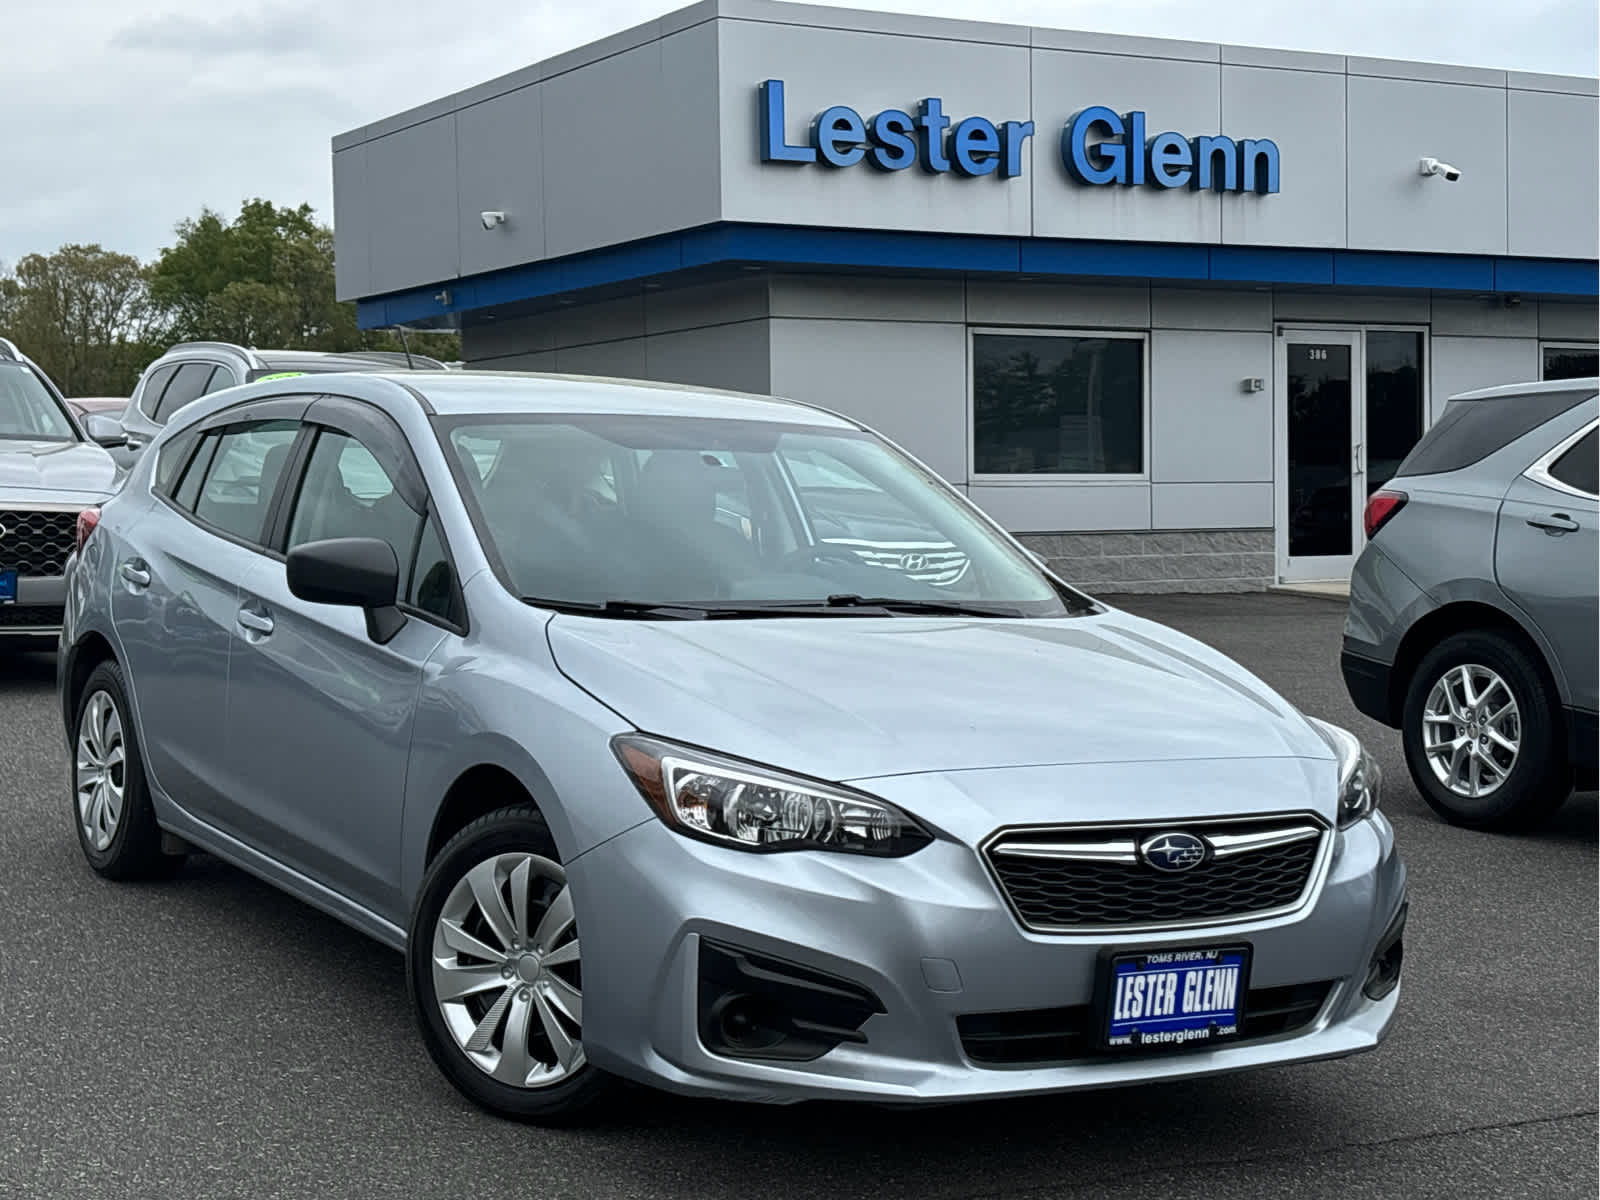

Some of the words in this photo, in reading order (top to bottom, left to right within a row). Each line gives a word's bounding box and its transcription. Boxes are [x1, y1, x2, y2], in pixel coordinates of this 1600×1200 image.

[758, 79, 1034, 178] Lester
[1061, 105, 1280, 194] Glenn
[1147, 955, 1173, 964] TOMS
[1206, 950, 1218, 959] NJ
[1114, 973, 1178, 1020] LESTER
[1182, 968, 1239, 1013] GLENN
[1141, 1029, 1209, 1044] lesterglenn
